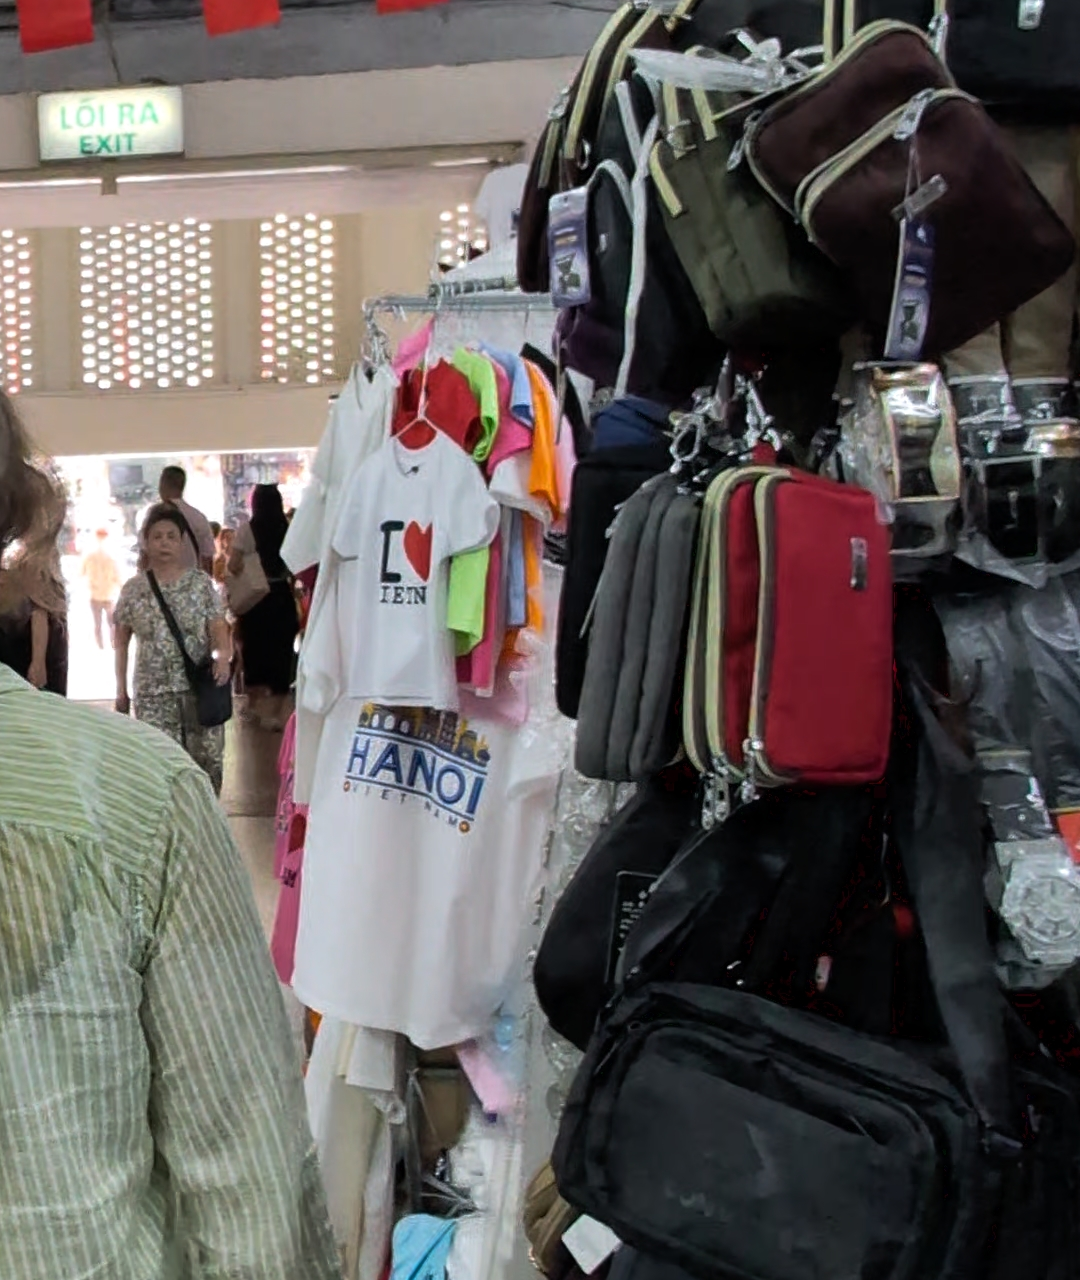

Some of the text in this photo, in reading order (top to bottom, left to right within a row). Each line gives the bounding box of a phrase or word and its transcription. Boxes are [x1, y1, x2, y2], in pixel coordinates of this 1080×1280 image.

[60, 96, 159, 130] LỐI RA
[79, 132, 138, 155] EXIT
[347, 735, 485, 815] HANOI
